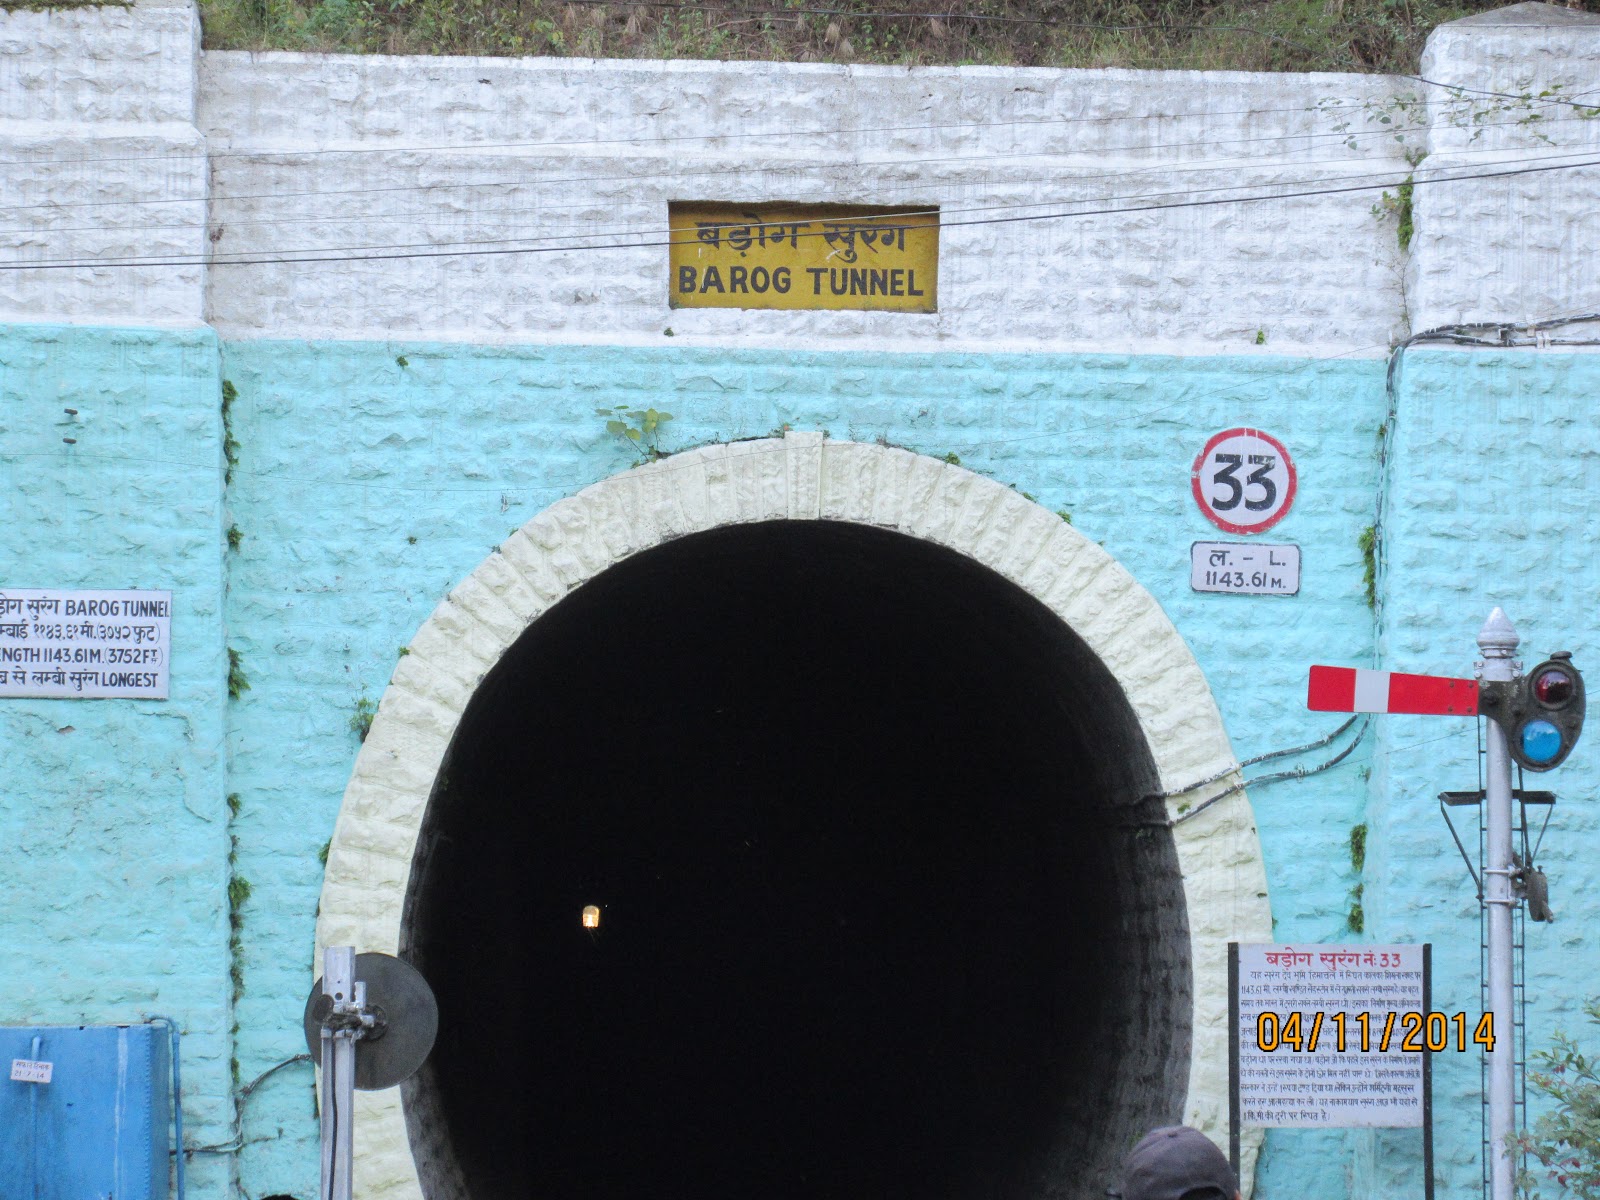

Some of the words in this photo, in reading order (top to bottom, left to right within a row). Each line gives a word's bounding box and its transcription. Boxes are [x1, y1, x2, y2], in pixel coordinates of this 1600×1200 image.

[694, 212, 810, 258] बड़ोग
[822, 216, 912, 263] सुरंग
[679, 266, 791, 294] BAROG
[806, 267, 924, 296] TUNNEL
[1211, 453, 1277, 511] 33
[1206, 571, 1266, 587] 1143.61
[27, 596, 61, 620] सुरंग
[65, 599, 119, 616] BAROG
[122, 600, 169, 617] TUNNEL
[12, 665, 26, 685] से
[32, 666, 66, 687] लम्बी
[69, 668, 99, 691] सुरंग
[102, 672, 158, 687] LONGEST
[1264, 946, 1314, 970] बड़ोग
[1319, 949, 1361, 971] सुरंग
